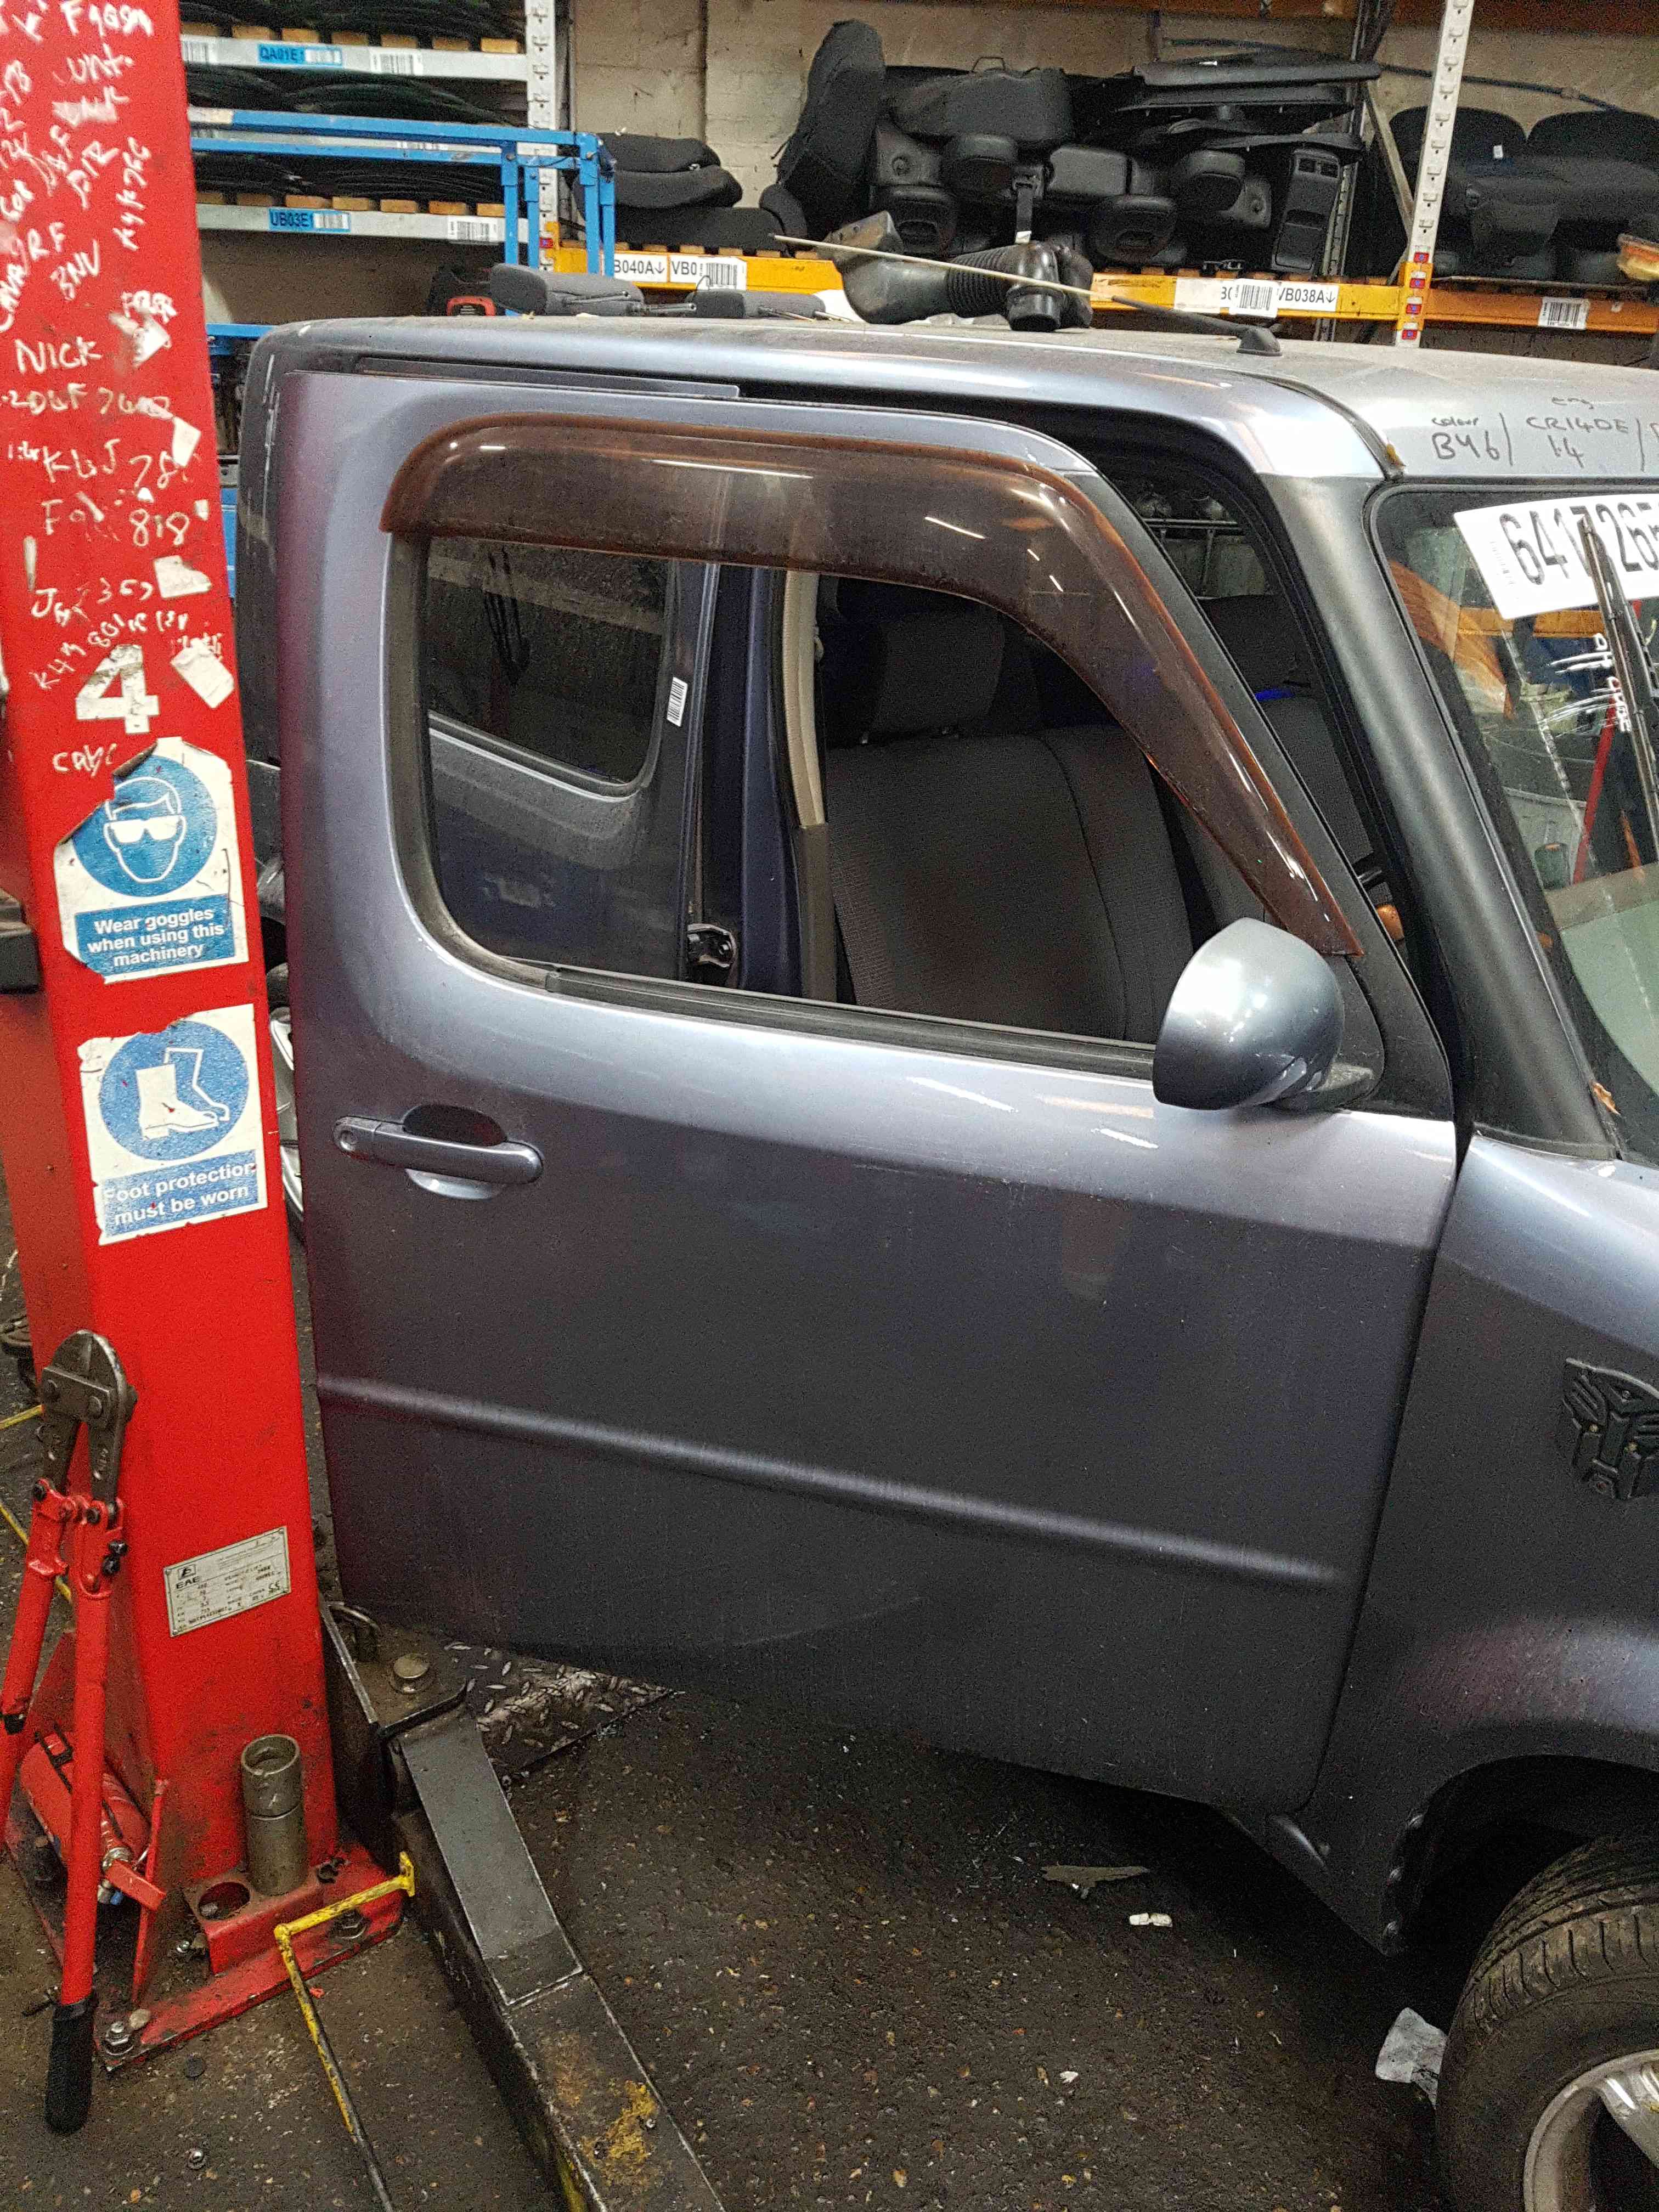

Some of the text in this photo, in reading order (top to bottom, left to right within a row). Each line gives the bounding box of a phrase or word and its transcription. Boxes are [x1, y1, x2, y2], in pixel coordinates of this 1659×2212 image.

[75, 644, 160, 735] 4
[94, 908, 215, 934] Wear goggles
[87, 922, 225, 954] when using this
[113, 942, 205, 968] machinery
[155, 1161, 257, 1199] protection
[114, 1184, 249, 1226] must be worn
[176, 1576, 202, 1589] EAE
